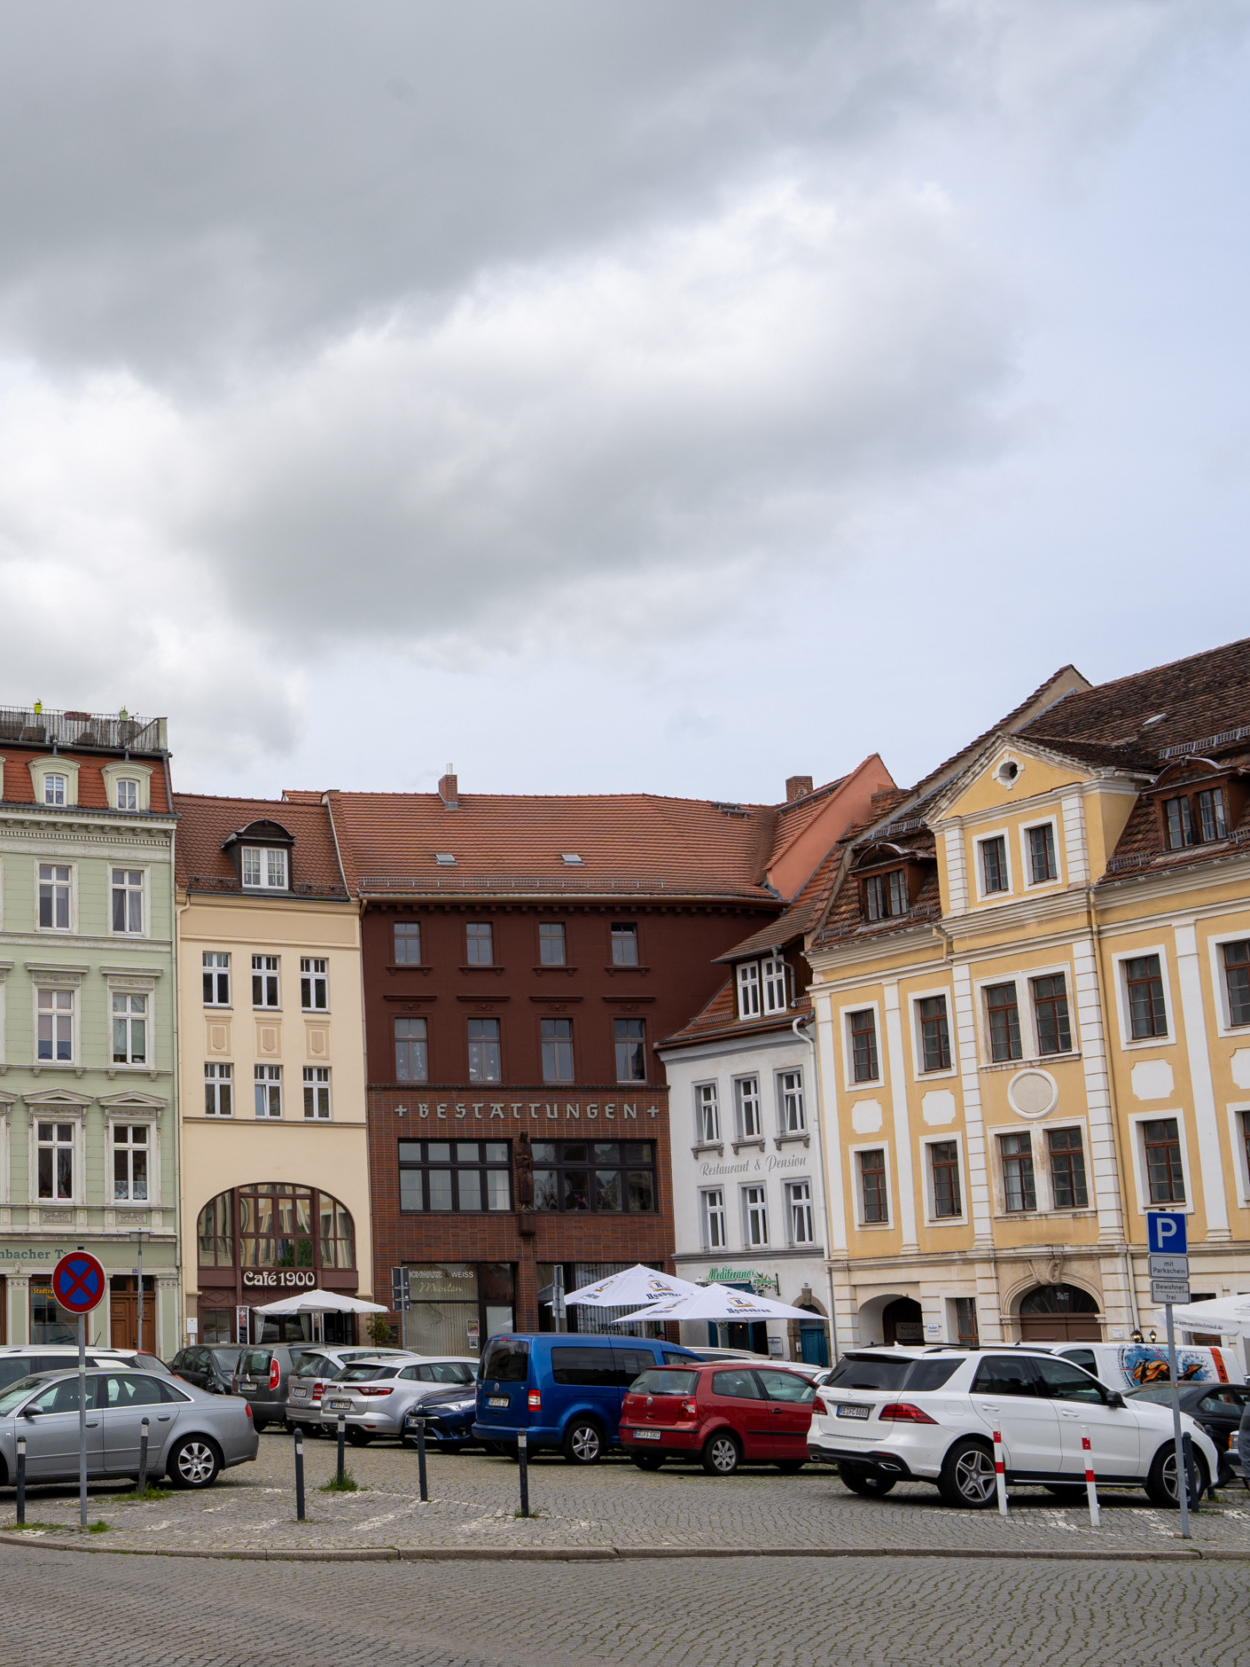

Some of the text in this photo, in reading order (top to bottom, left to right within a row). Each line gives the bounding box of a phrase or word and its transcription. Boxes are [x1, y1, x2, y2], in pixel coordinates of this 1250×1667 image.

[418, 1103, 638, 1119] BESTATTUNGEN
[700, 1154, 806, 1176] Restaurant & Pension
[1156, 1217, 1177, 1249] P
[243, 1271, 315, 1286] Café 1900
